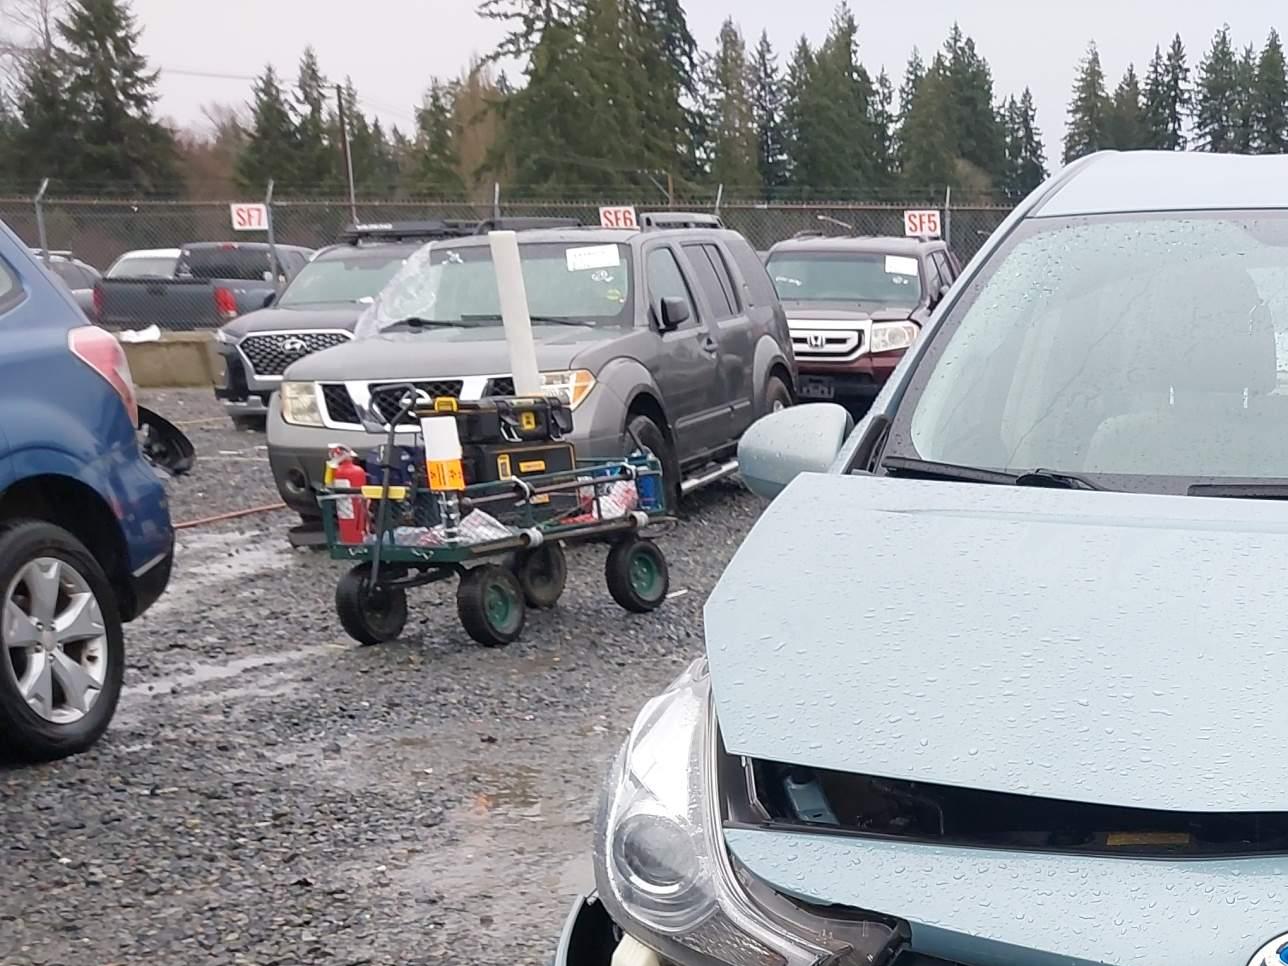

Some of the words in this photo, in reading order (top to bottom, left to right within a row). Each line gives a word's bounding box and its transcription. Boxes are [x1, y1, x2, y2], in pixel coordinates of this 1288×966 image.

[236, 207, 262, 226] SF7
[603, 210, 634, 228] SF6
[908, 213, 937, 232] SF5
